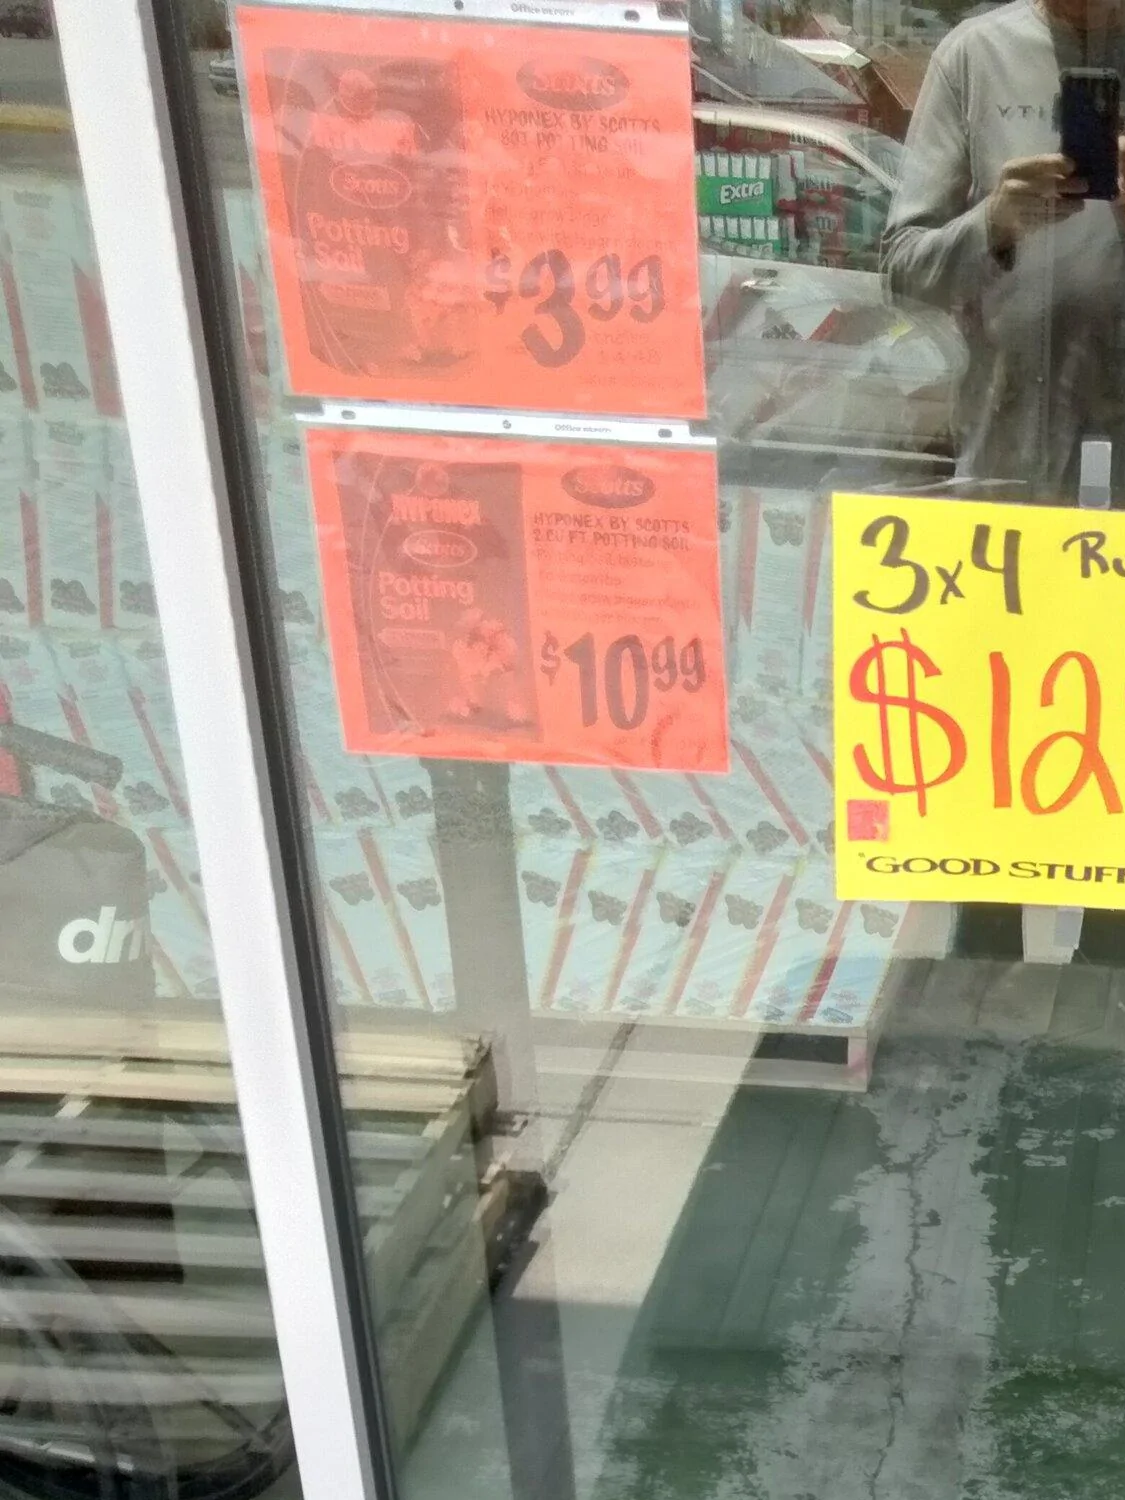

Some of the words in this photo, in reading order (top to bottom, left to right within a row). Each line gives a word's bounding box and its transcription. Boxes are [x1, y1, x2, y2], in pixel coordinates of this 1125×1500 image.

[569, 112, 593, 131] BY
[720, 181, 765, 205] Extra
[306, 212, 410, 255] Potting
[533, 512, 604, 529] HYPONEX
[609, 515, 628, 530] BY
[635, 518, 691, 534] SCOTTS
[378, 571, 475, 606] Potting
[379, 597, 431, 622] Soil
